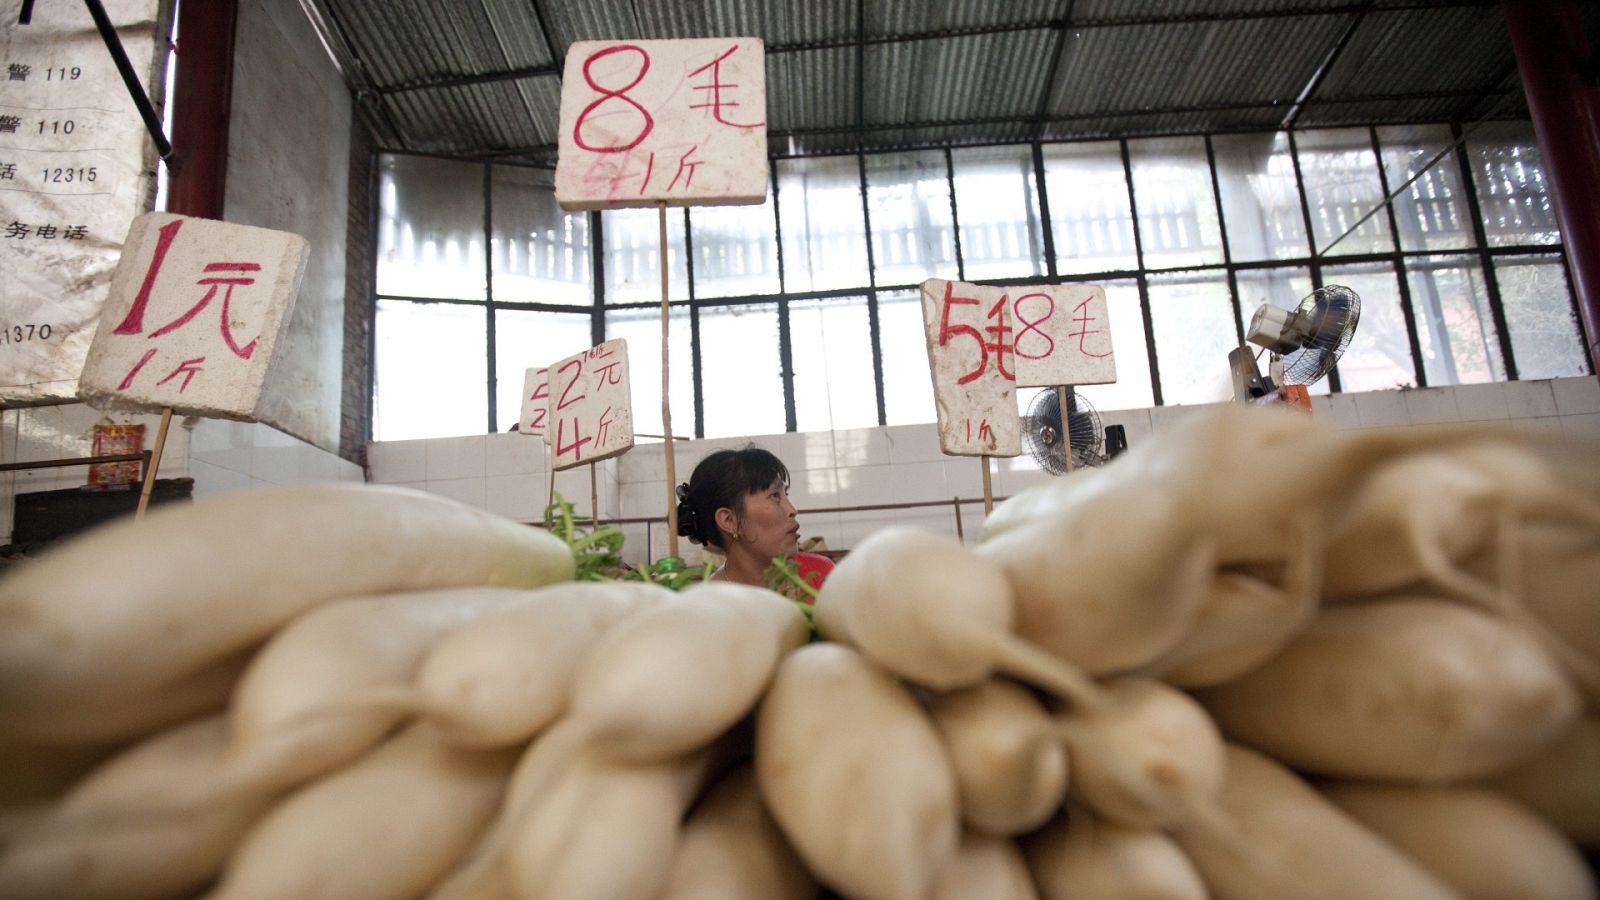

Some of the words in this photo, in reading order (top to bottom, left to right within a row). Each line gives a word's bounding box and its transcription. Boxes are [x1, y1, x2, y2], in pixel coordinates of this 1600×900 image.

[46, 67, 81, 81] 119
[39, 120, 74, 134] 110
[43, 167, 97, 182] 12315
[5, 221, 88, 240] 务电话
[112, 219, 262, 360] 1元
[117, 348, 206, 394] 1斤
[556, 351, 622, 411] 2元
[556, 406, 613, 461] 4斤
